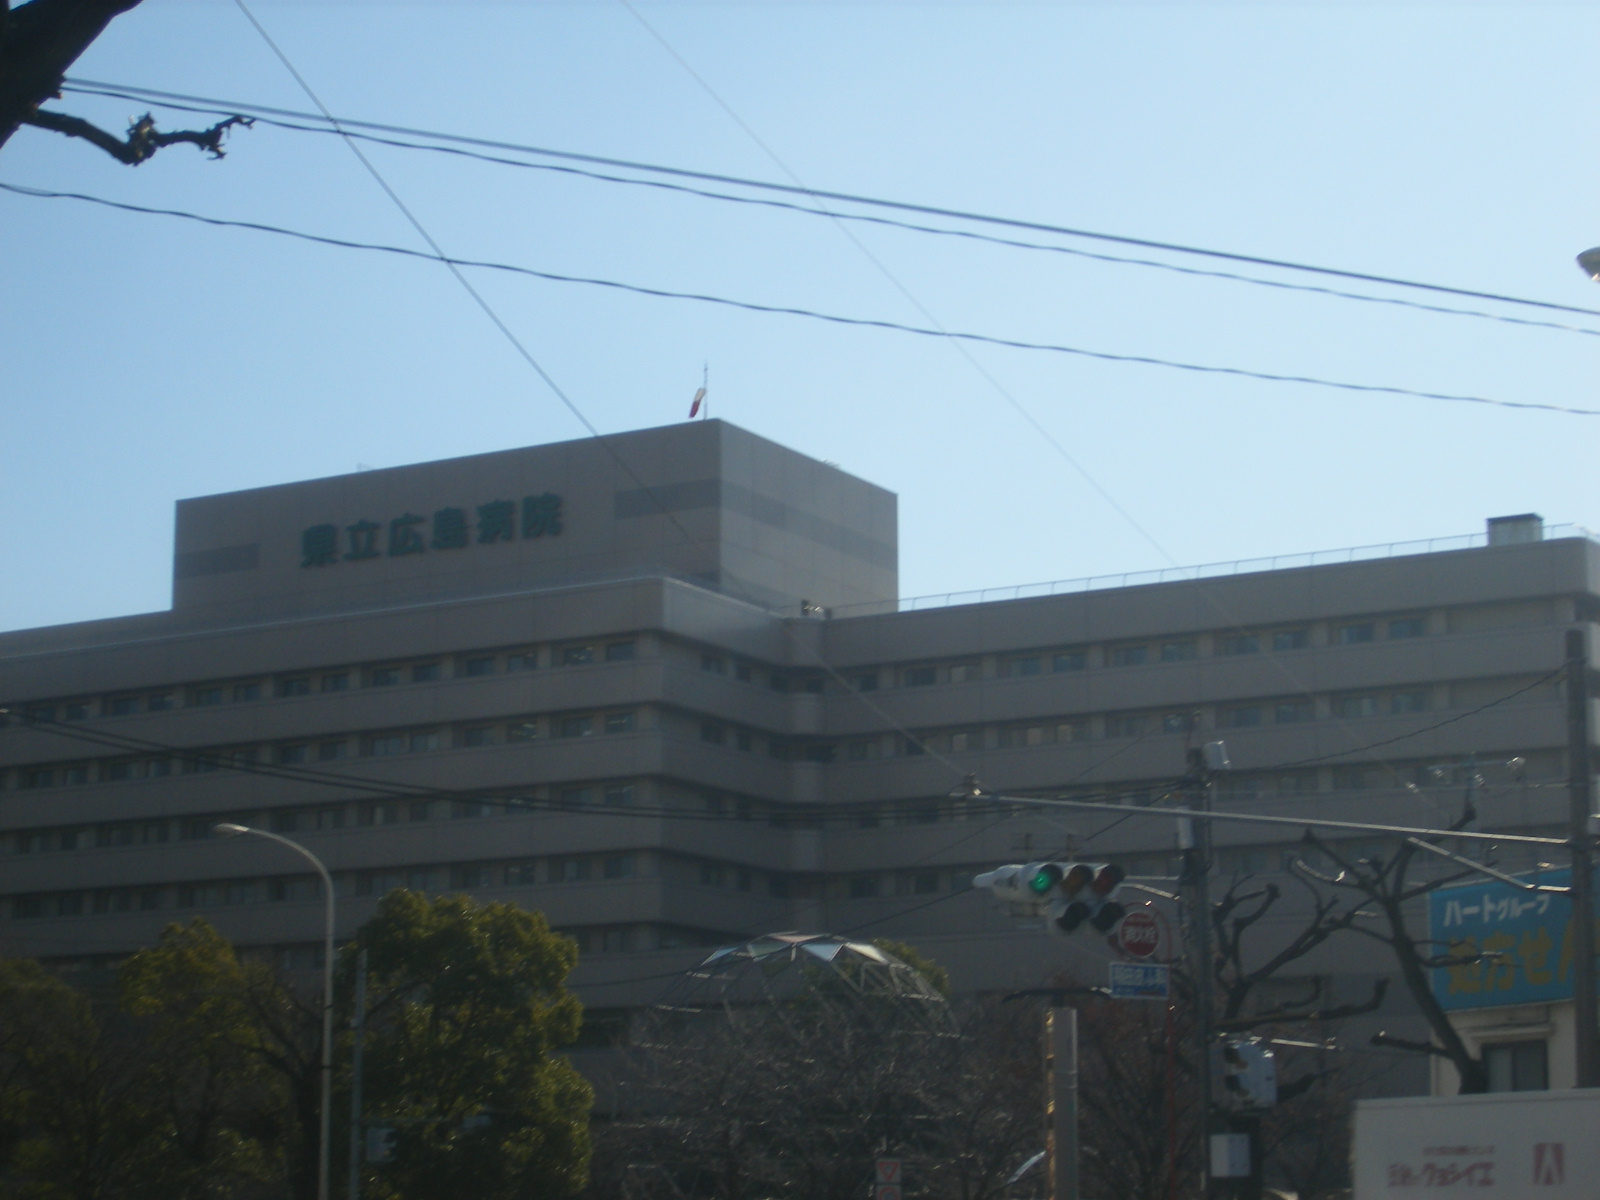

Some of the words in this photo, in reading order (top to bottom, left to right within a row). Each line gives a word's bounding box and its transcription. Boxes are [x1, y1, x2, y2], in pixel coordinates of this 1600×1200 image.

[300, 490, 564, 568] 県立広島病院
